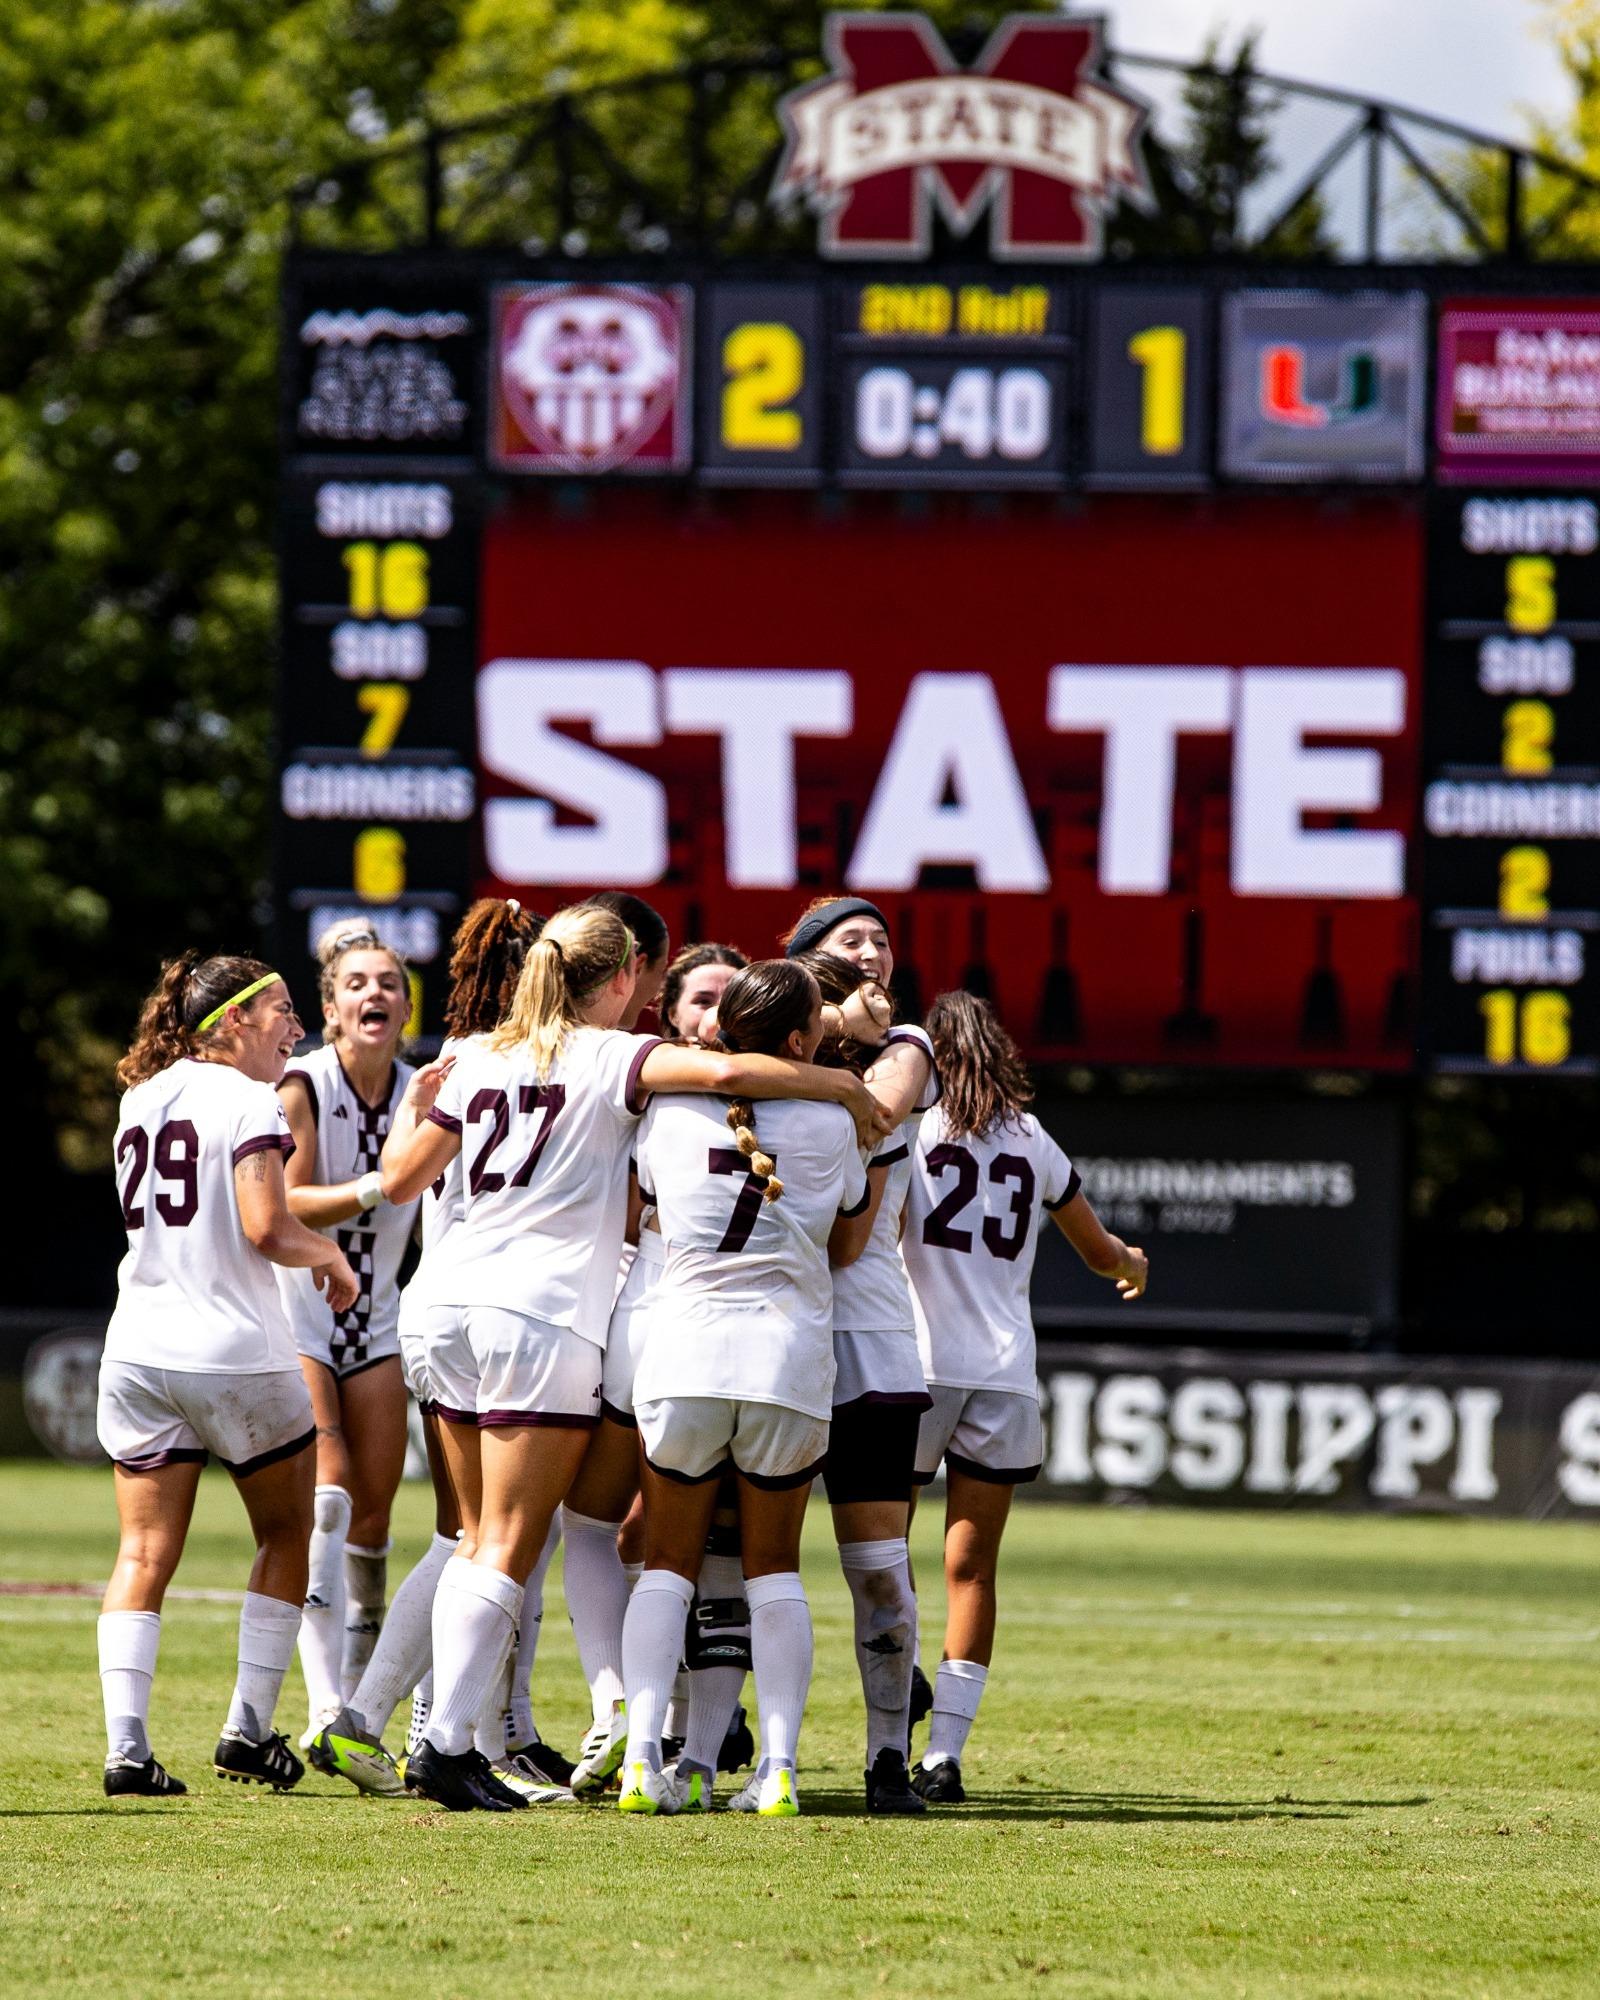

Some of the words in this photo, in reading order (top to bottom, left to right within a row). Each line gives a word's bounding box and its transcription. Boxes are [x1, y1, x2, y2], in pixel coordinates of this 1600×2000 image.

[848, 92, 1078, 164] STATE
[721, 323, 804, 450] 2
[855, 366, 1051, 459] 0:40
[1127, 325, 1187, 456] 1
[315, 481, 454, 539] SHOTS
[1461, 496, 1600, 556] SHOTS
[341, 541, 430, 619] 16
[1504, 556, 1557, 634] 5
[357, 681, 411, 760] 7
[1502, 699, 1557, 776] 2
[281, 763, 476, 822] CORNERS
[475, 657, 1407, 899] STATE
[353, 826, 406, 904] 6
[1499, 845, 1551, 923] 2
[1452, 928, 1585, 985] FOULS
[1478, 989, 1571, 1066] 16
[117, 1119, 199, 1230] 29
[466, 1084, 566, 1197] 27
[708, 1147, 777, 1253] 7
[922, 1143, 1036, 1262] 23
